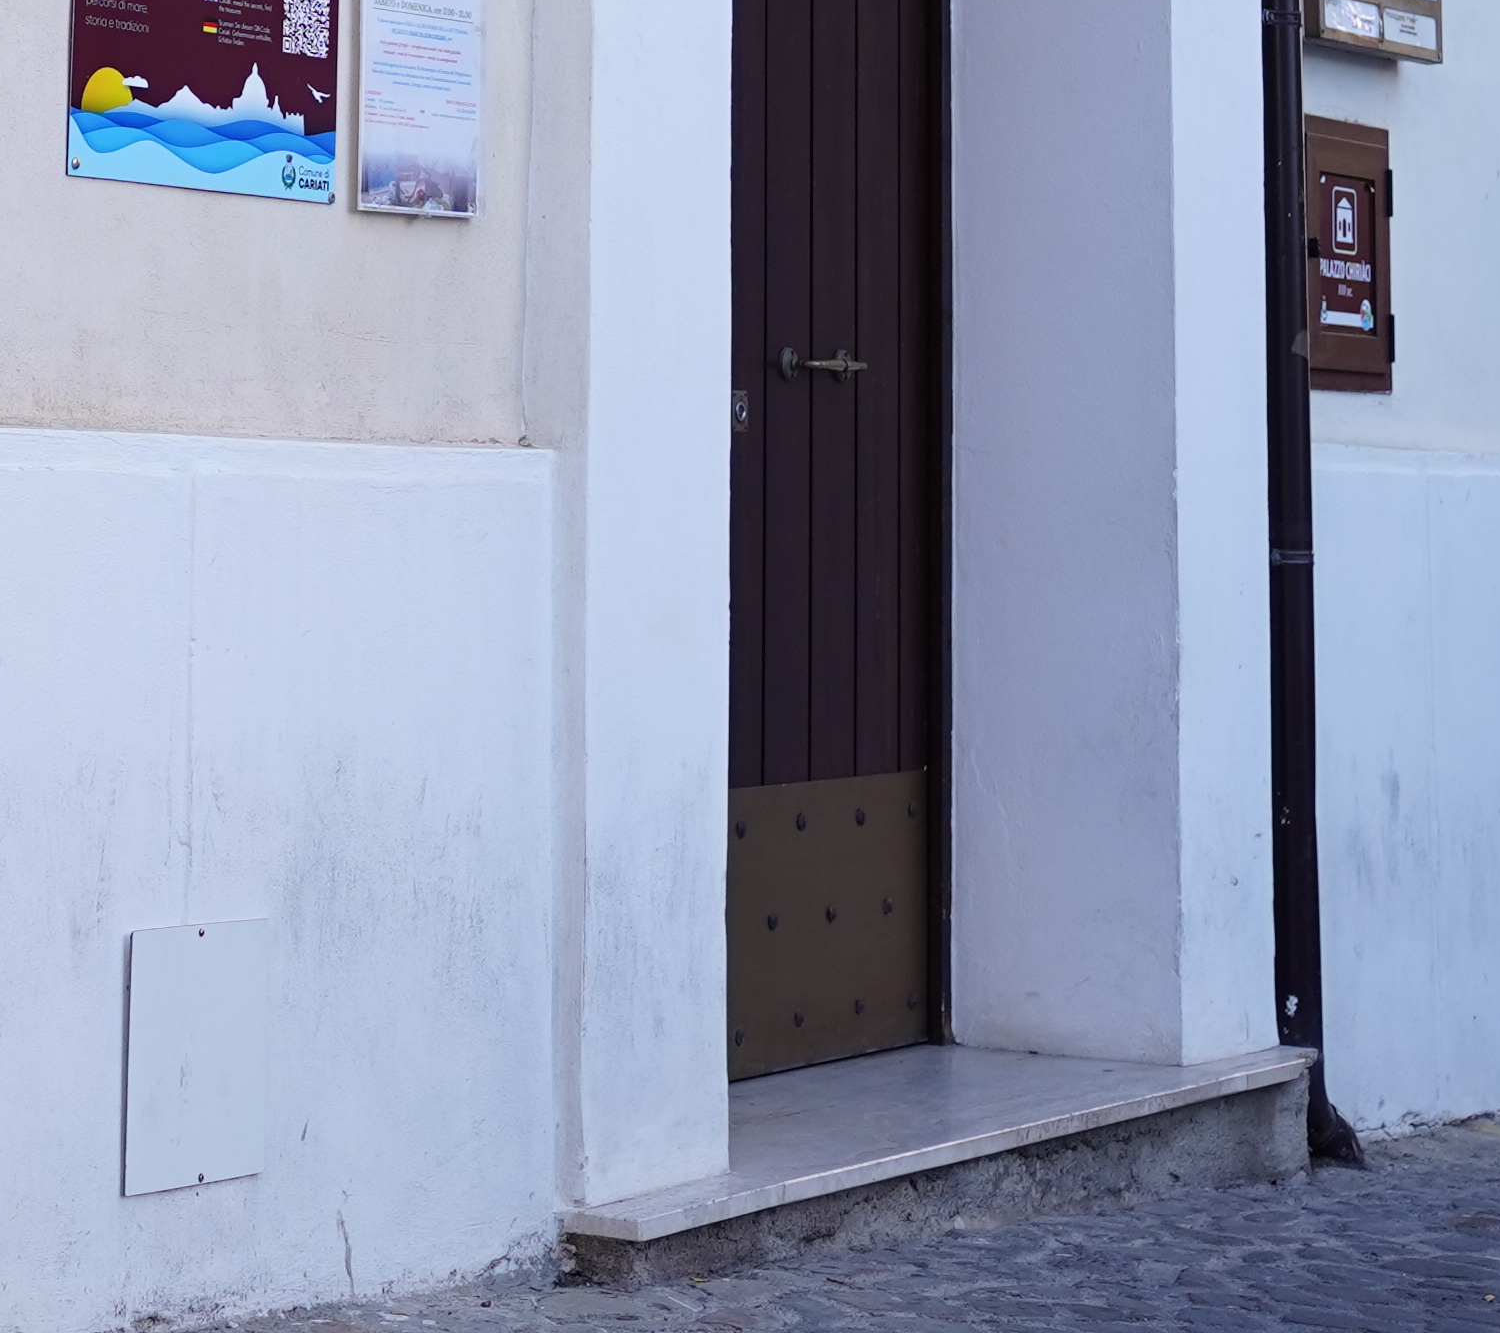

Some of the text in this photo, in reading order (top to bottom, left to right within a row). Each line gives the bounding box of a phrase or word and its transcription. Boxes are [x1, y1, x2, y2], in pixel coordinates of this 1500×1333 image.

[108, 19, 115, 28] e
[298, 178, 330, 191] CARIATI
[1320, 257, 1345, 280] PALAZZO
